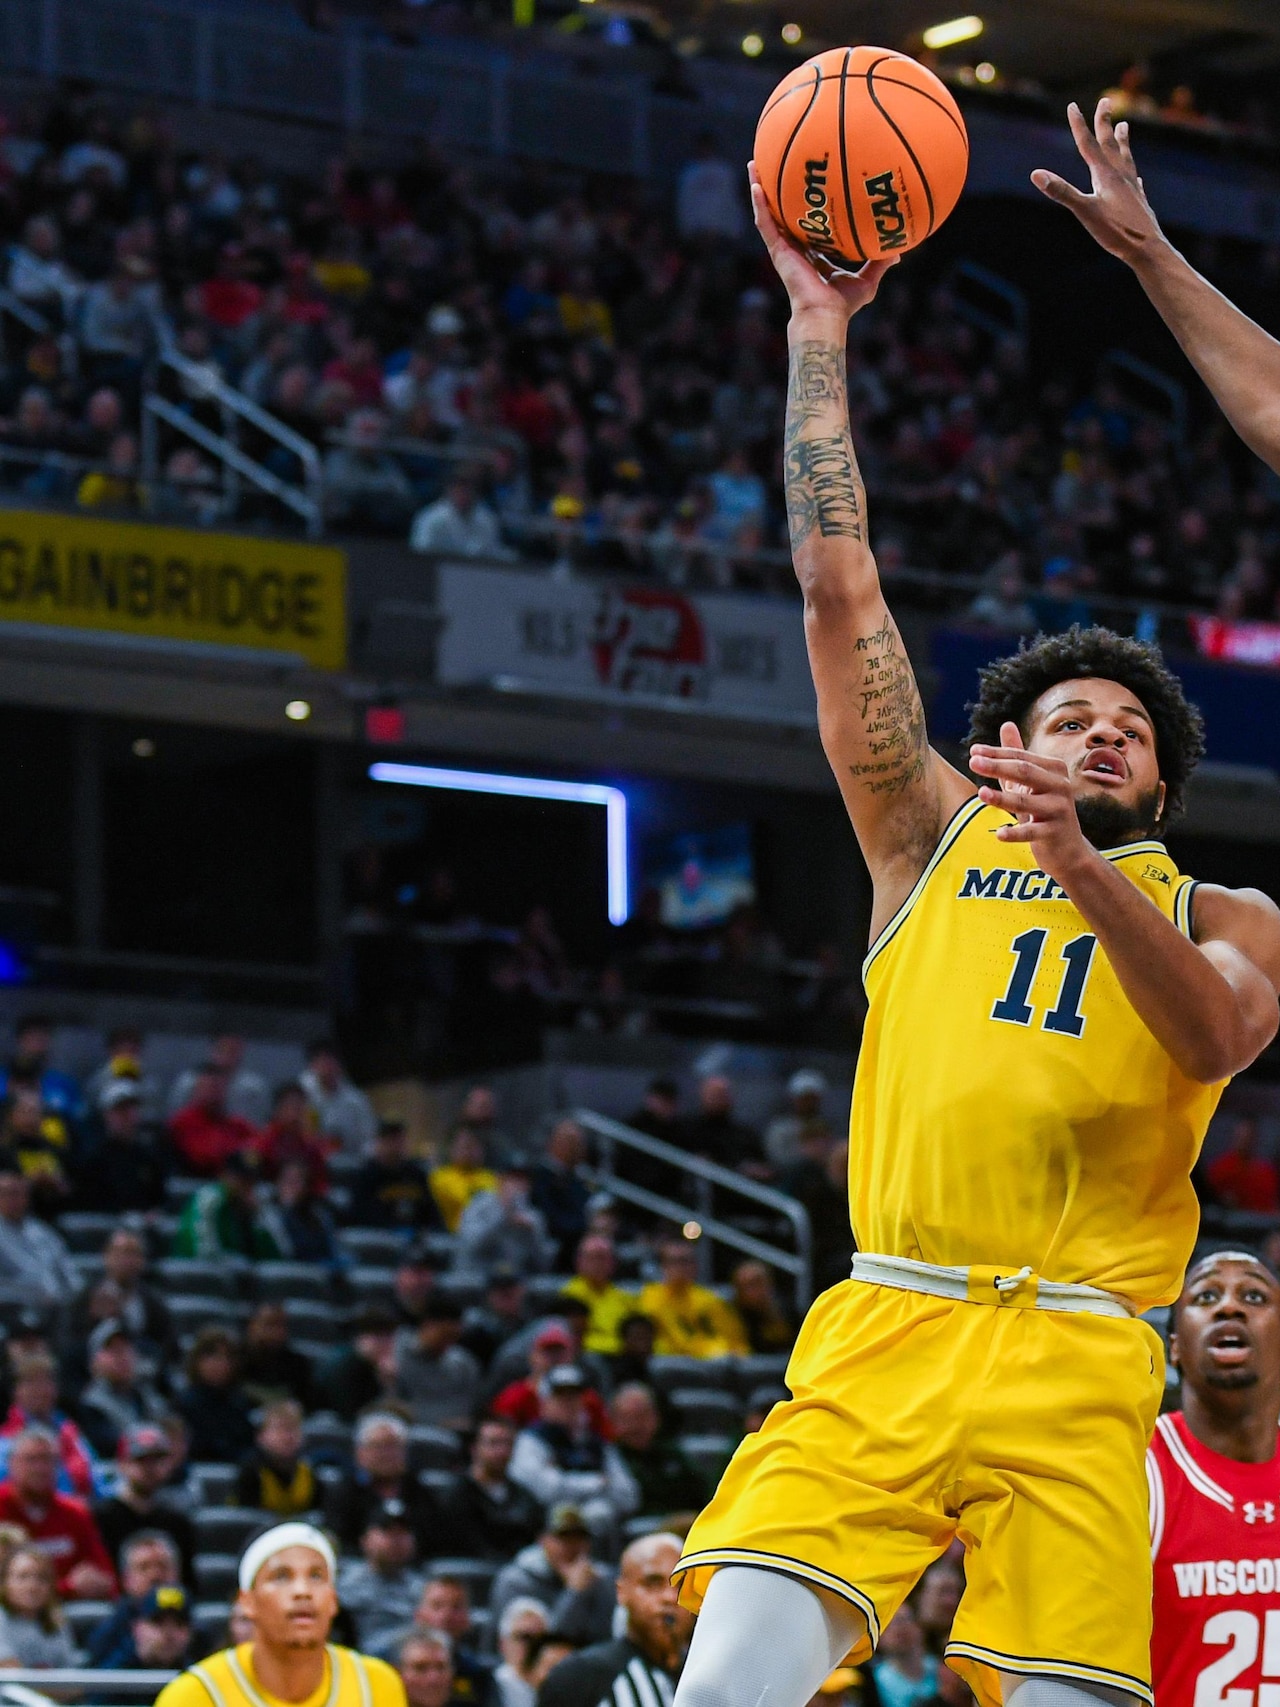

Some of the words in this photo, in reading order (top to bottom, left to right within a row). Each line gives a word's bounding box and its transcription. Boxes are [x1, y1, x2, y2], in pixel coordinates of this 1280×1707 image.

[864, 169, 907, 252] NCAA
[0, 537, 323, 639] GAINBRIDGE
[865, 657, 880, 670] BE
[865, 720, 889, 733] THAT
[988, 927, 1098, 1040] 11
